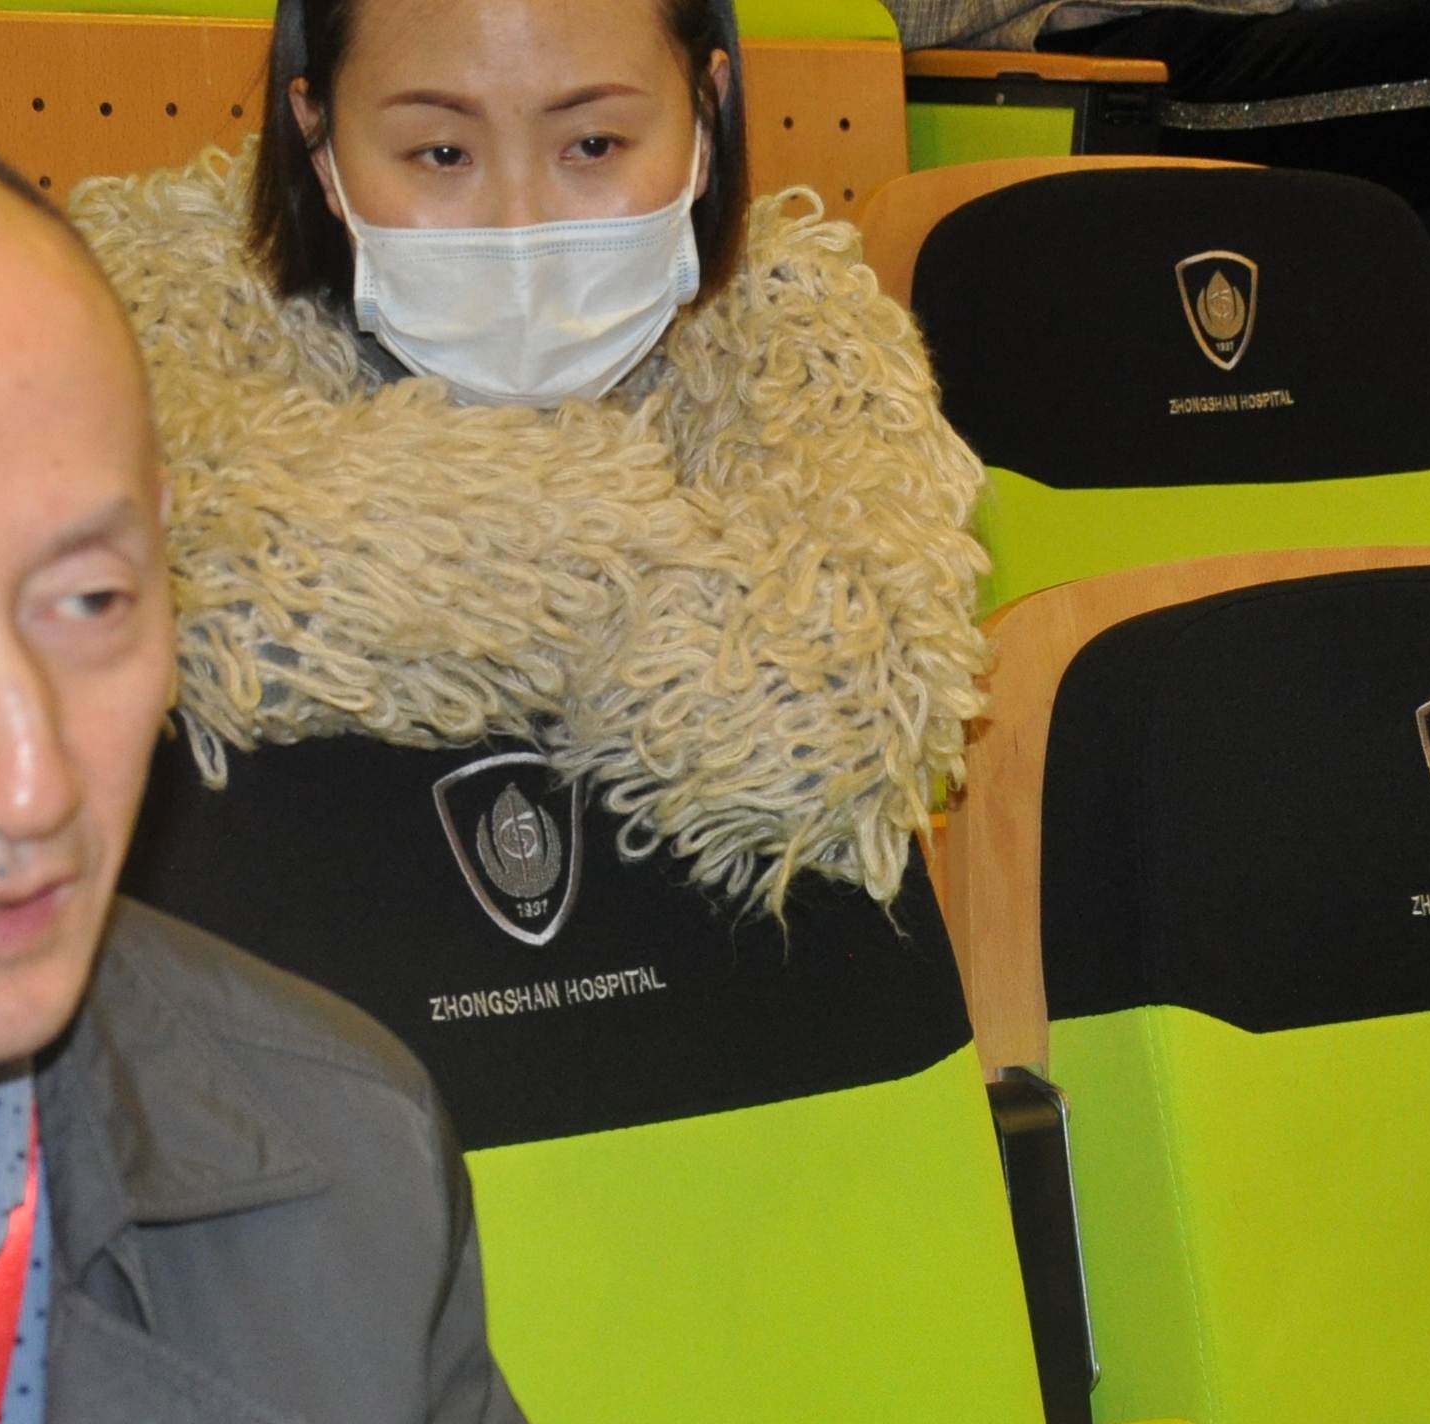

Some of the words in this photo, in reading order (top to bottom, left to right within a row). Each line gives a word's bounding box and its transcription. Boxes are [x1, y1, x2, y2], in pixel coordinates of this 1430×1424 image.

[1169, 395, 1238, 414] ZHONGSHAN
[1240, 390, 1294, 409] HOSPITAL
[429, 981, 561, 1021] ZHONGSHAN
[565, 965, 668, 1005] HOSPITAL
